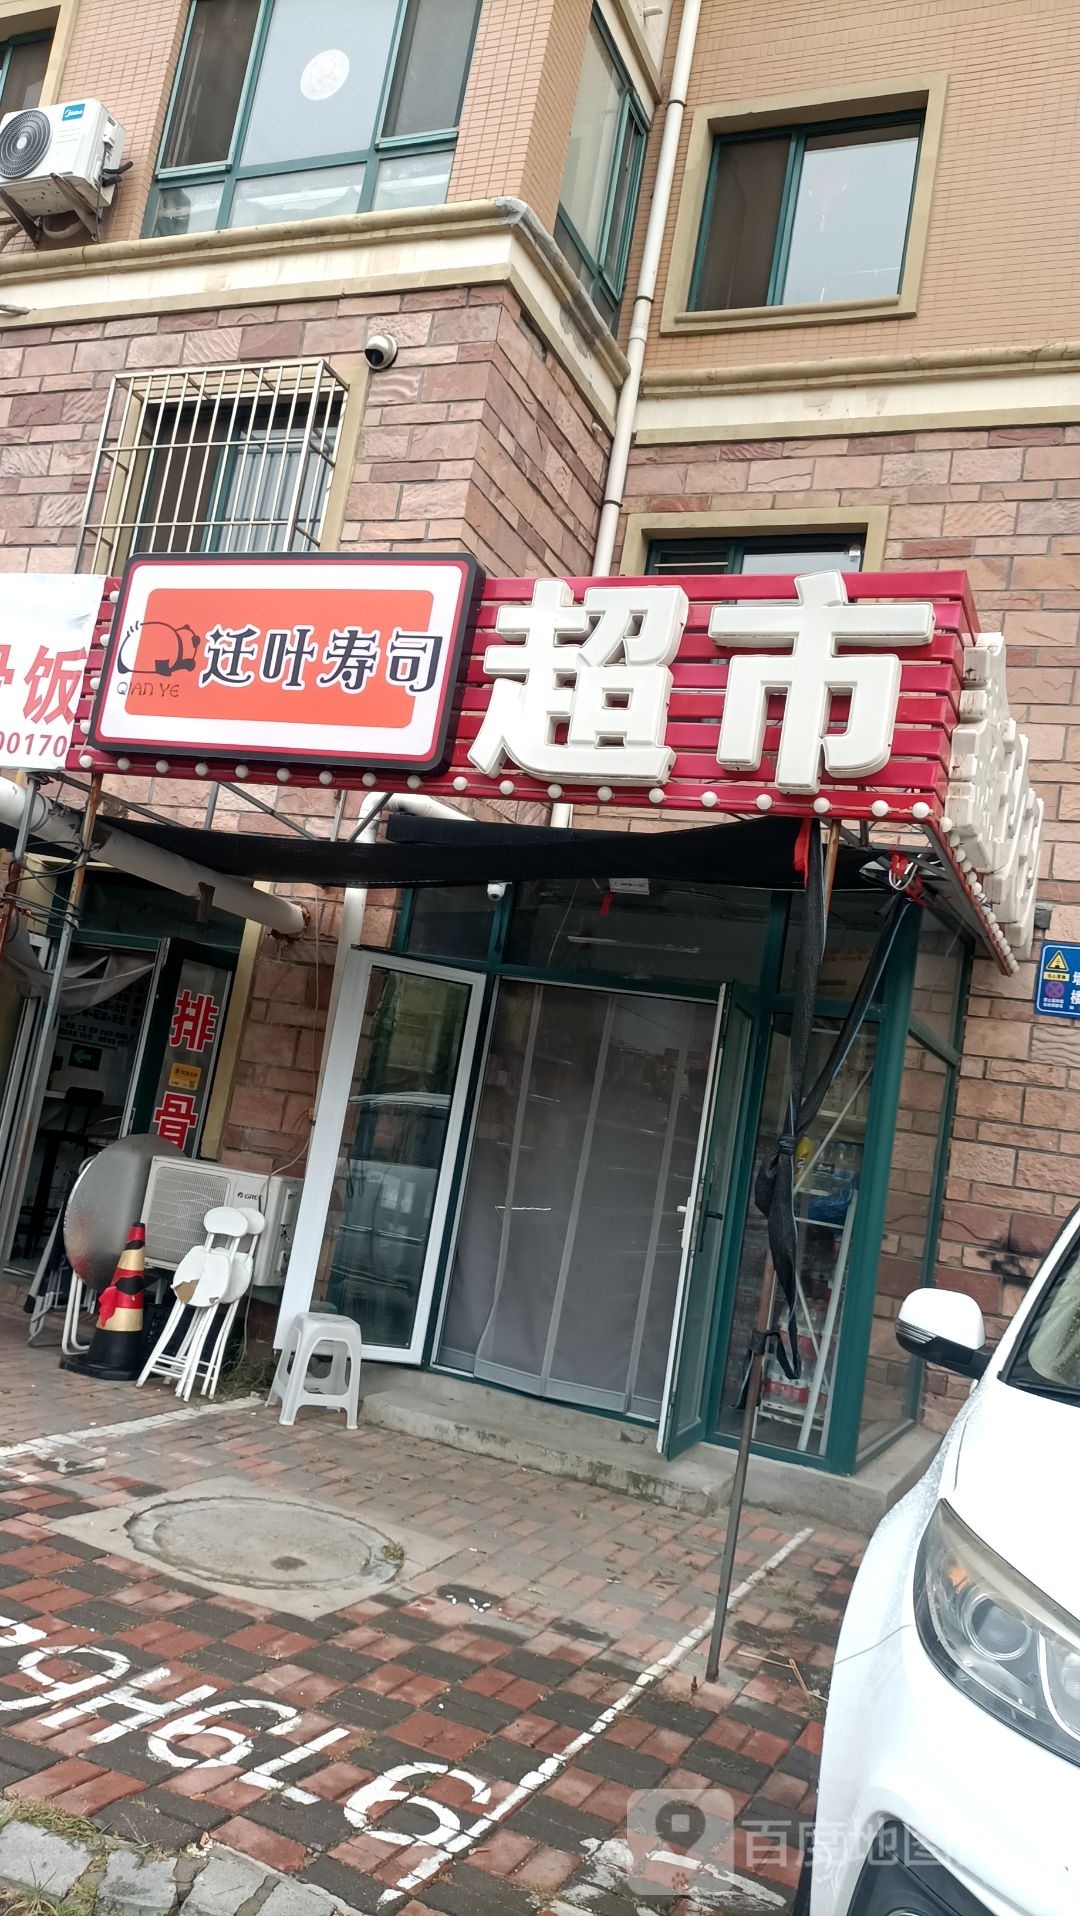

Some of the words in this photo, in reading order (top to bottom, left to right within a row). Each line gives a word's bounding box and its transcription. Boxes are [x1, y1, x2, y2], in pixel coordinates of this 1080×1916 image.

[0, 644, 88, 725] 饭
[117, 681, 154, 697] QIAN
[159, 683, 180, 698] YE
[201, 626, 443, 693] 迁叶寿司
[467, 568, 935, 796] 超市
